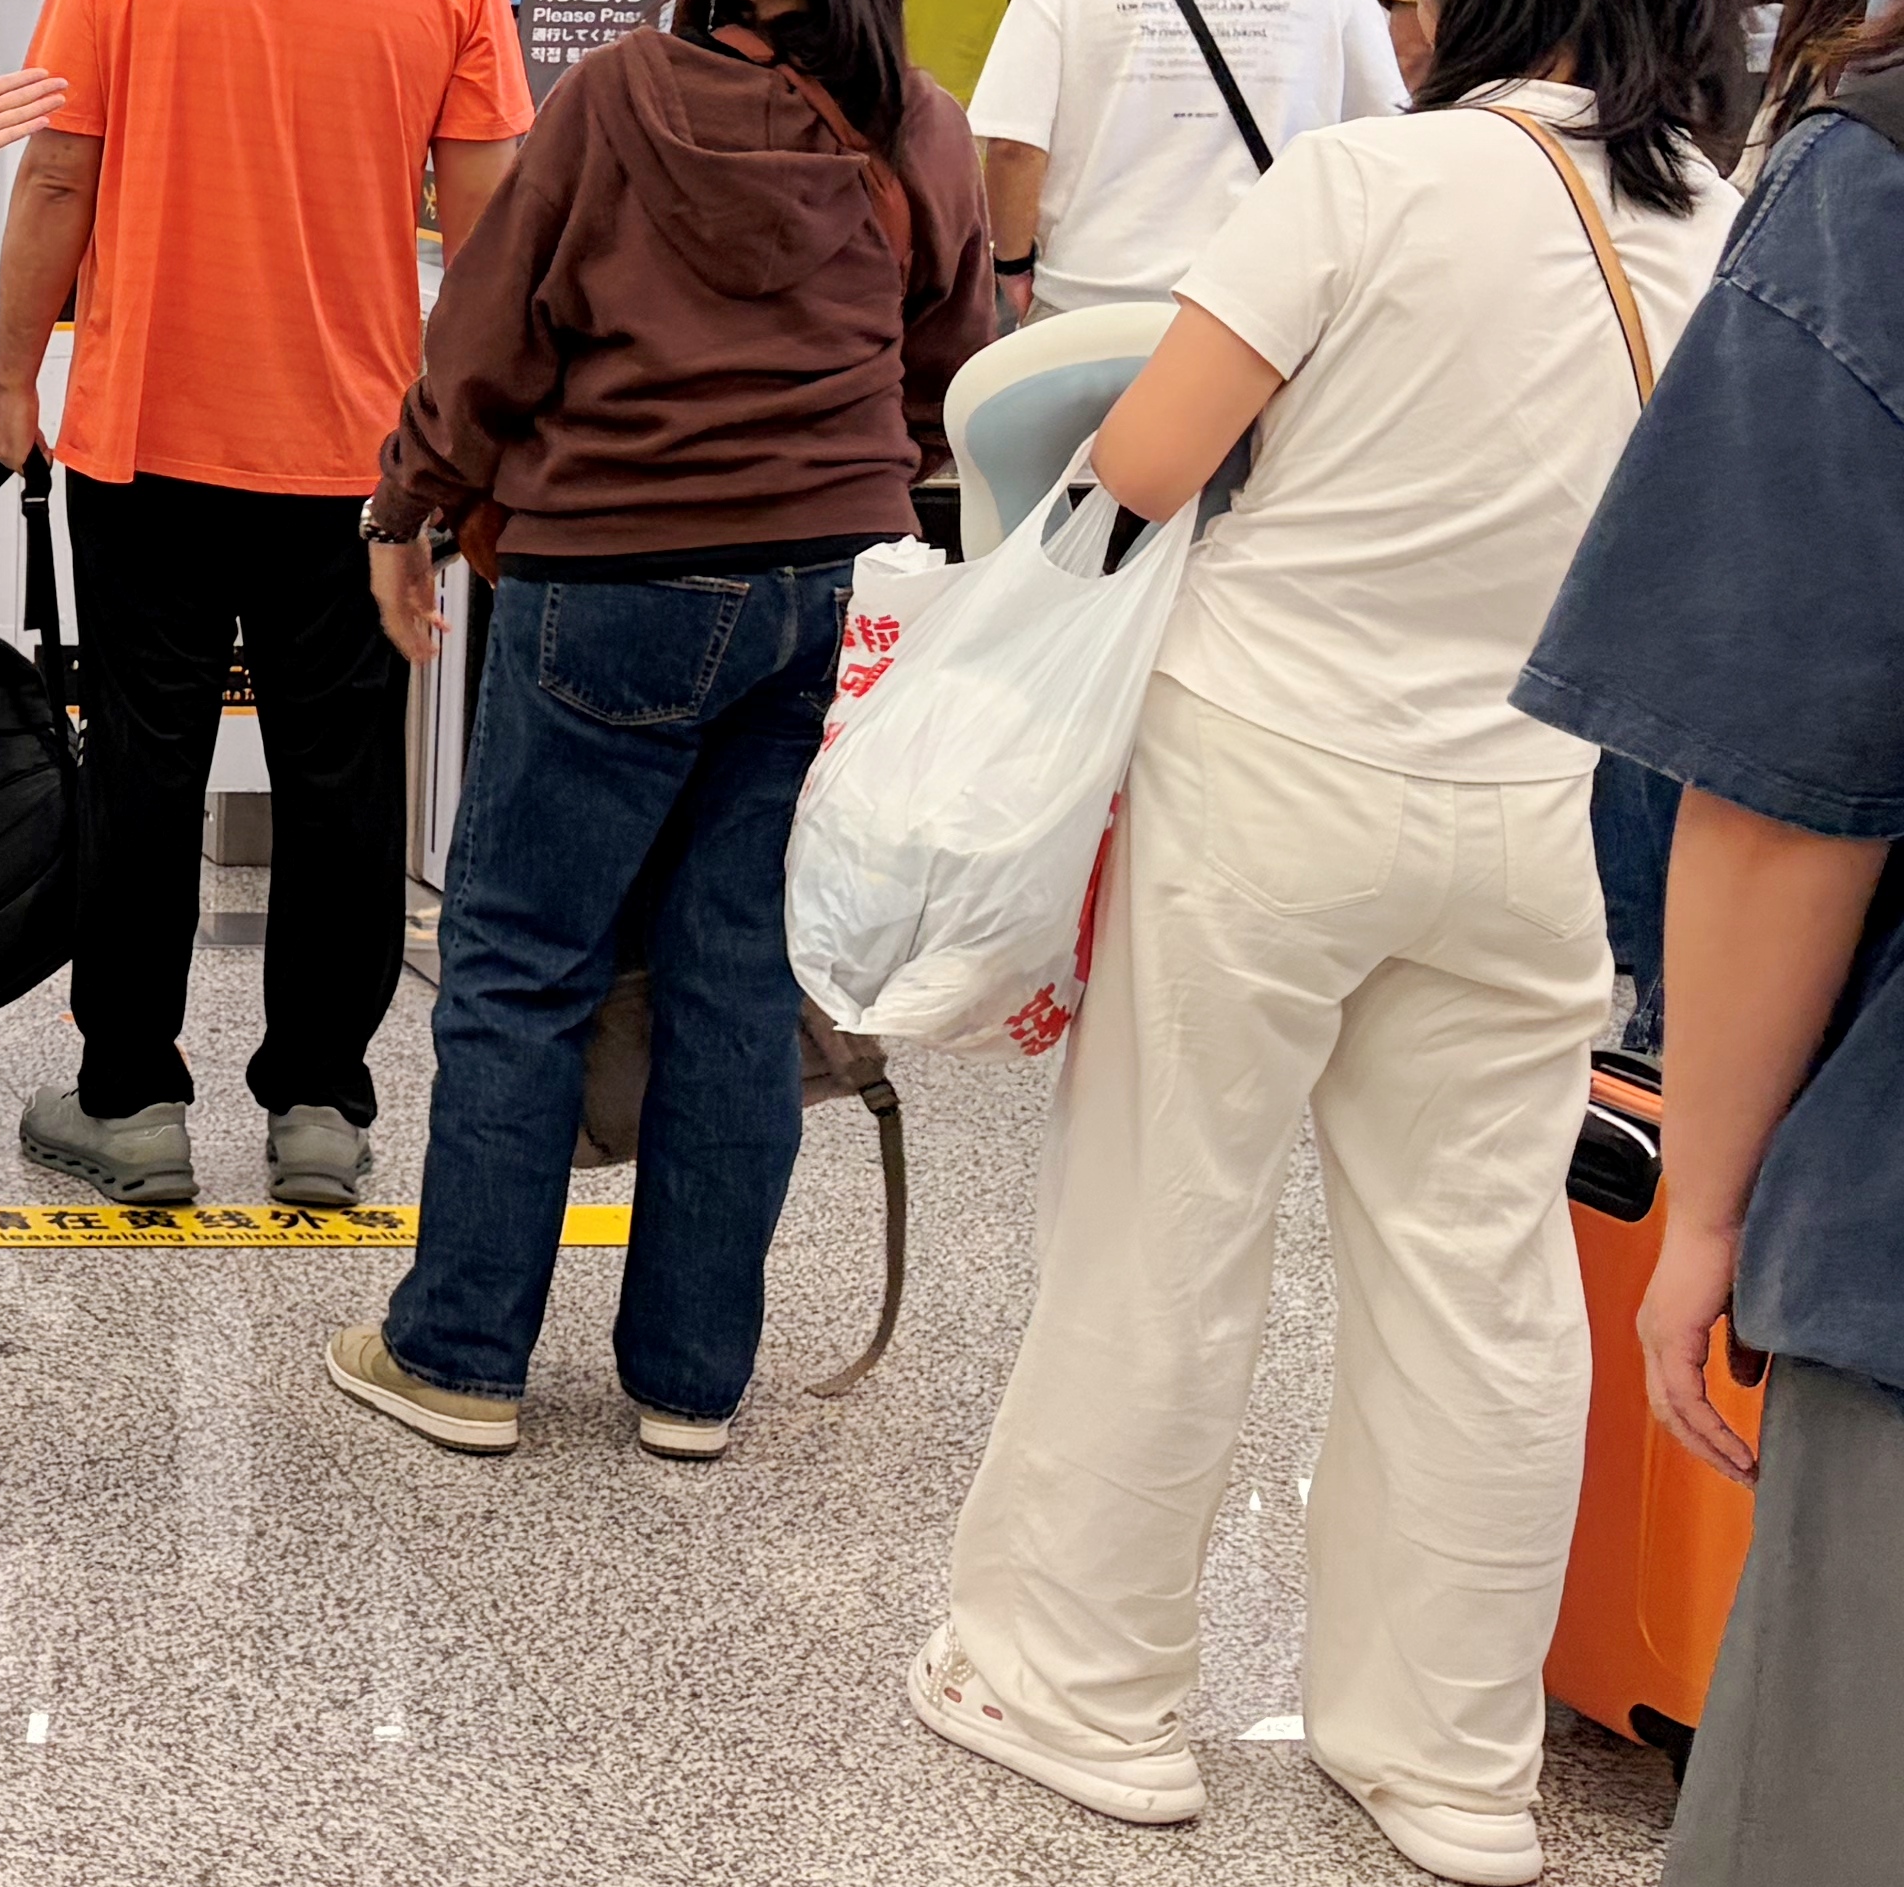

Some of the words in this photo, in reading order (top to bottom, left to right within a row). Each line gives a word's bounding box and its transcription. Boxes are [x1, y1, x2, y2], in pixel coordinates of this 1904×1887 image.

[533, 8, 596, 24] Please
[532, 28, 629, 43] 通行してくだ
[80, 1231, 185, 1242] waiting
[191, 1231, 290, 1241] behind
[295, 1231, 341, 1241] the
[348, 1232, 416, 1242] yello
